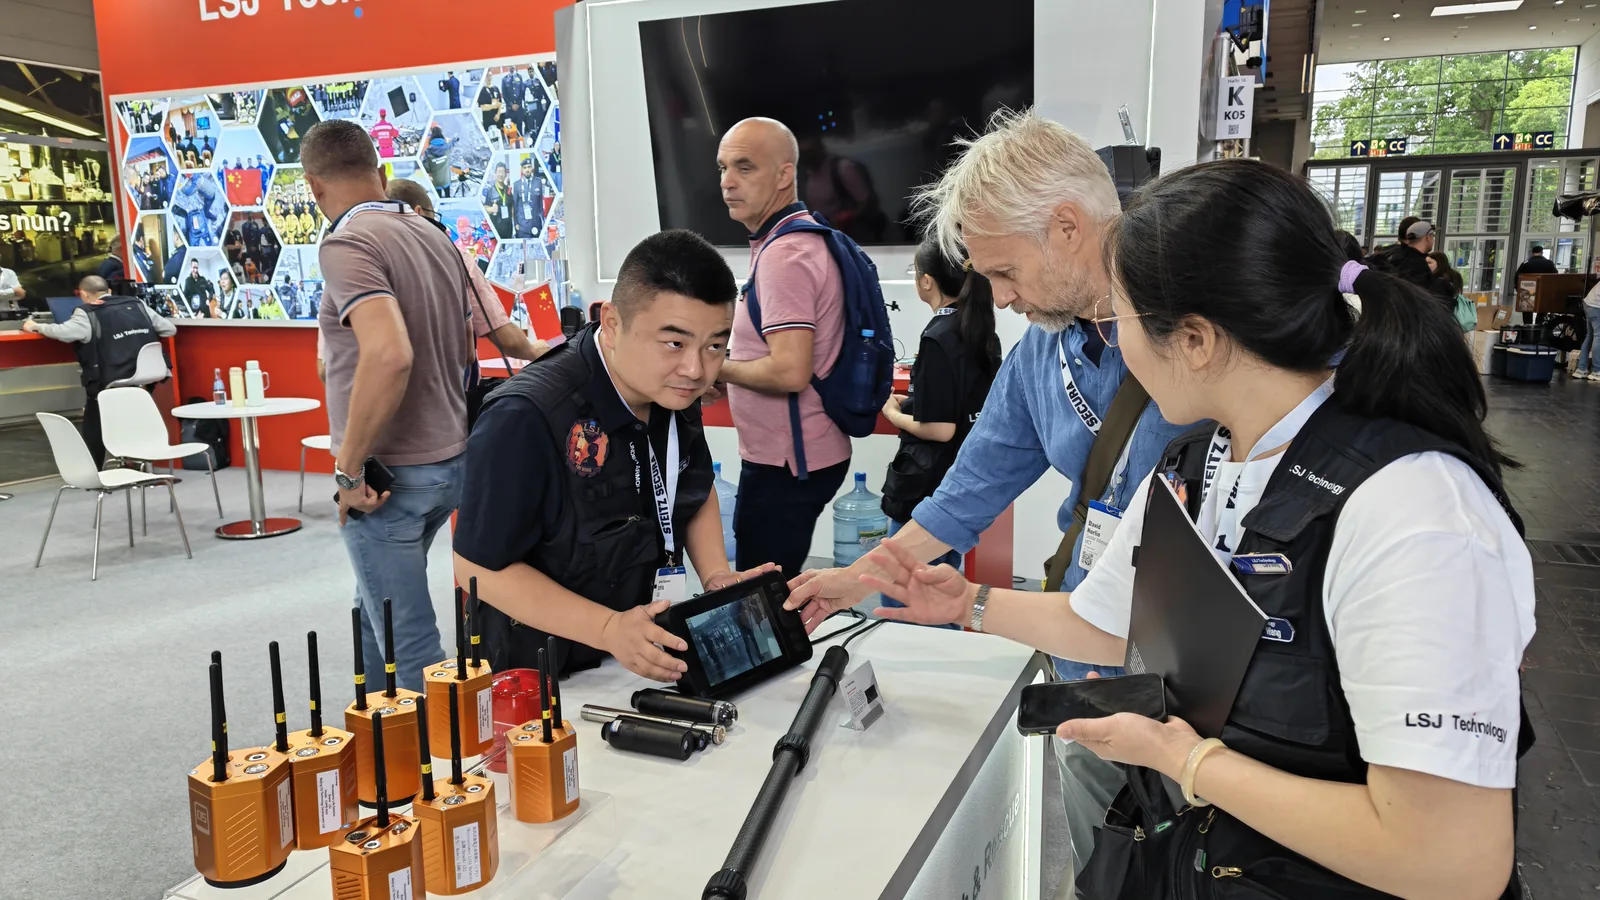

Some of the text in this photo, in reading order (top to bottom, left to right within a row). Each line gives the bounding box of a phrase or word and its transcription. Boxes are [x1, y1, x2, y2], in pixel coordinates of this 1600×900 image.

[1228, 85, 1245, 106] K
[1389, 140, 1405, 151] CC
[1536, 134, 1553, 145] CC
[16, 211, 72, 232] nun?
[1066, 380, 1099, 427] SECURA
[583, 422, 601, 435] LSJ
[1288, 464, 1346, 495] SJ Technogy
[650, 454, 672, 535] STEITZ SECURA
[1405, 712, 1508, 743] LSJ Technology
